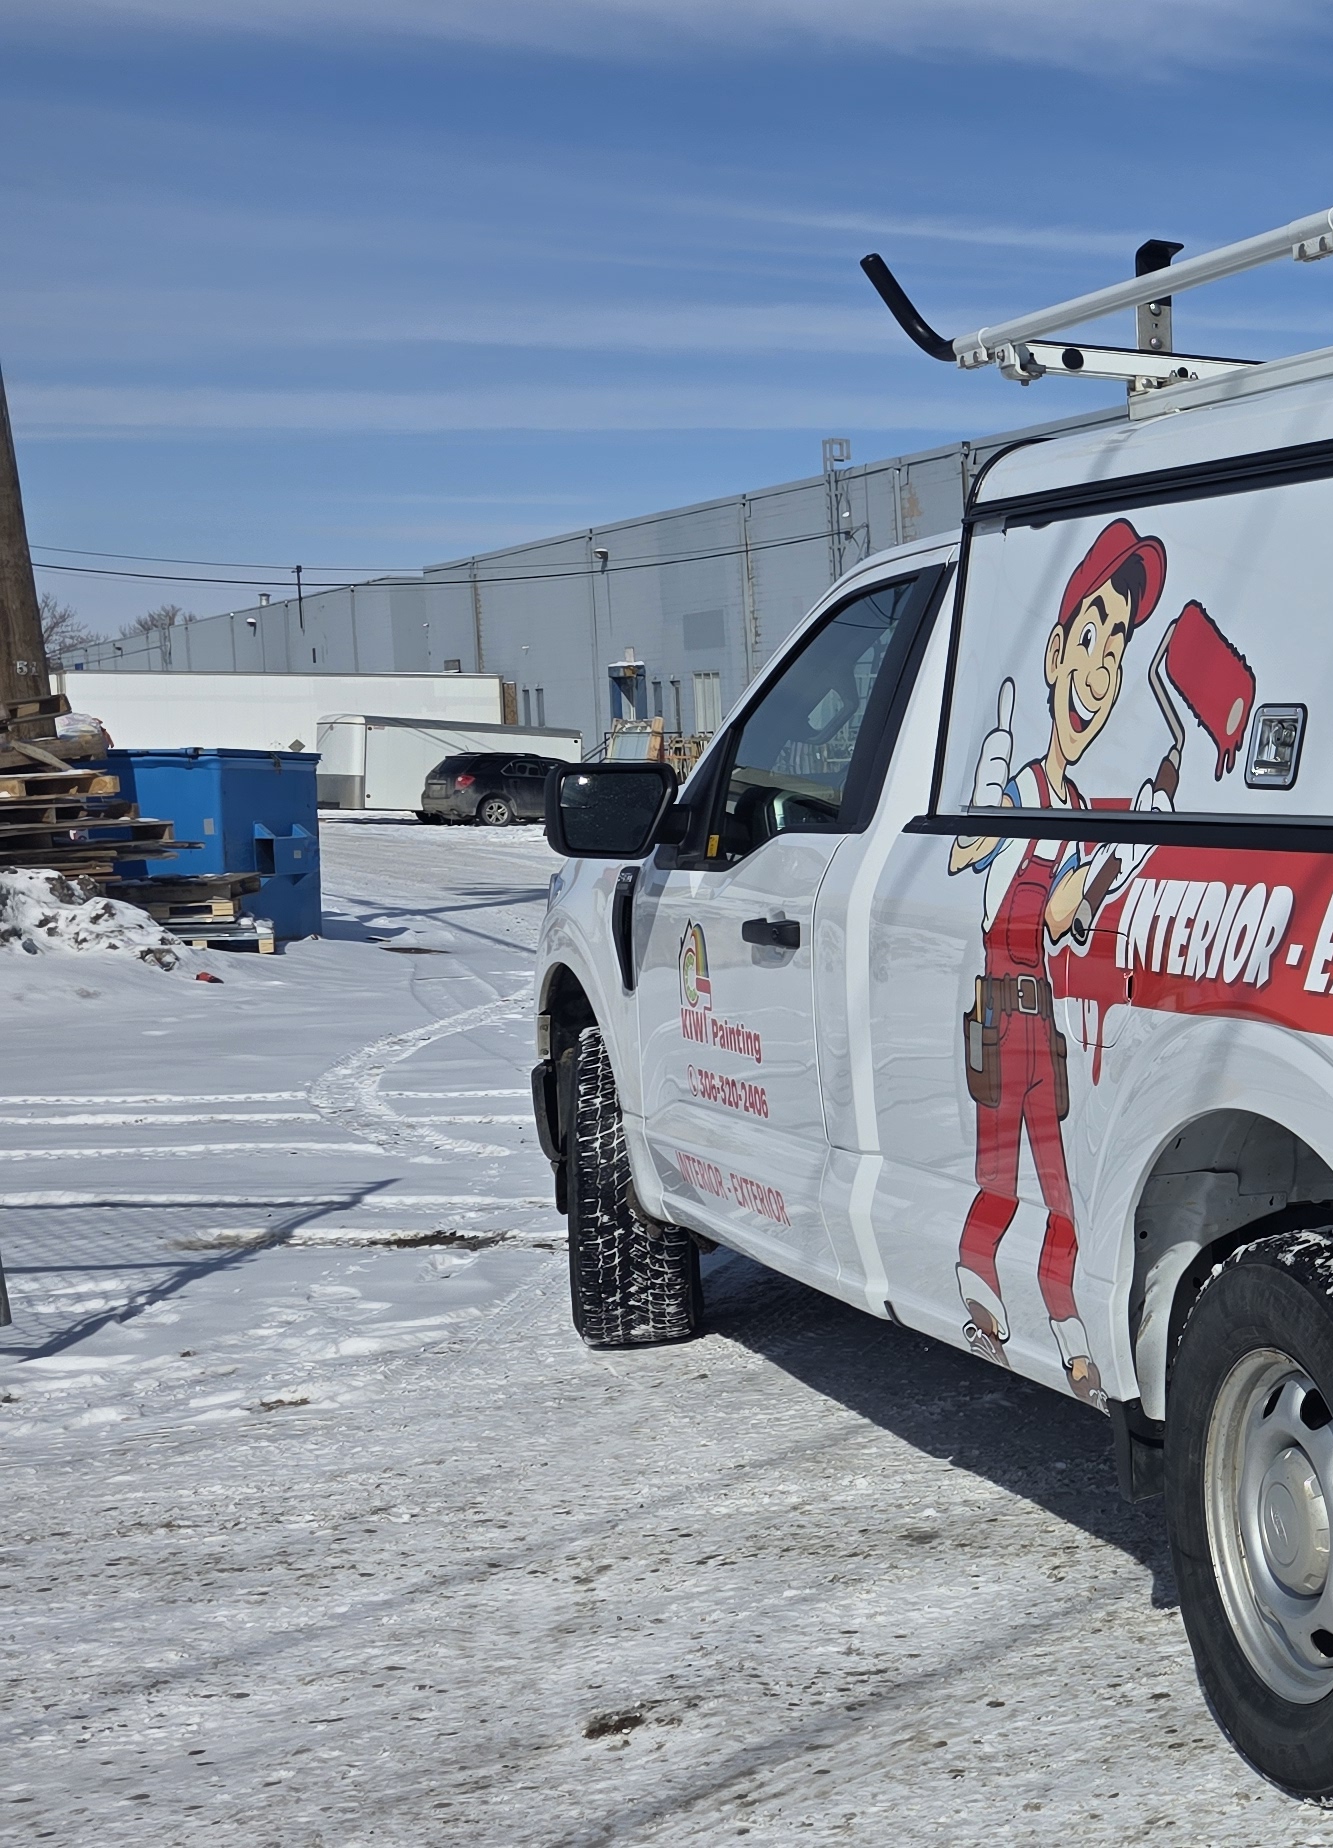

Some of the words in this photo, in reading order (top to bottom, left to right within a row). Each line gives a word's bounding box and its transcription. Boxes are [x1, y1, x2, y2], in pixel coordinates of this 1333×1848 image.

[1115, 877, 1294, 989] INTERIOR
[681, 1008, 709, 1044] KIWI
[711, 1017, 762, 1064] Painting
[697, 1069, 769, 1119] 306-320-2406
[675, 1150, 729, 1201] INTERIOR
[730, 1172, 792, 1227] EXTERIOR
